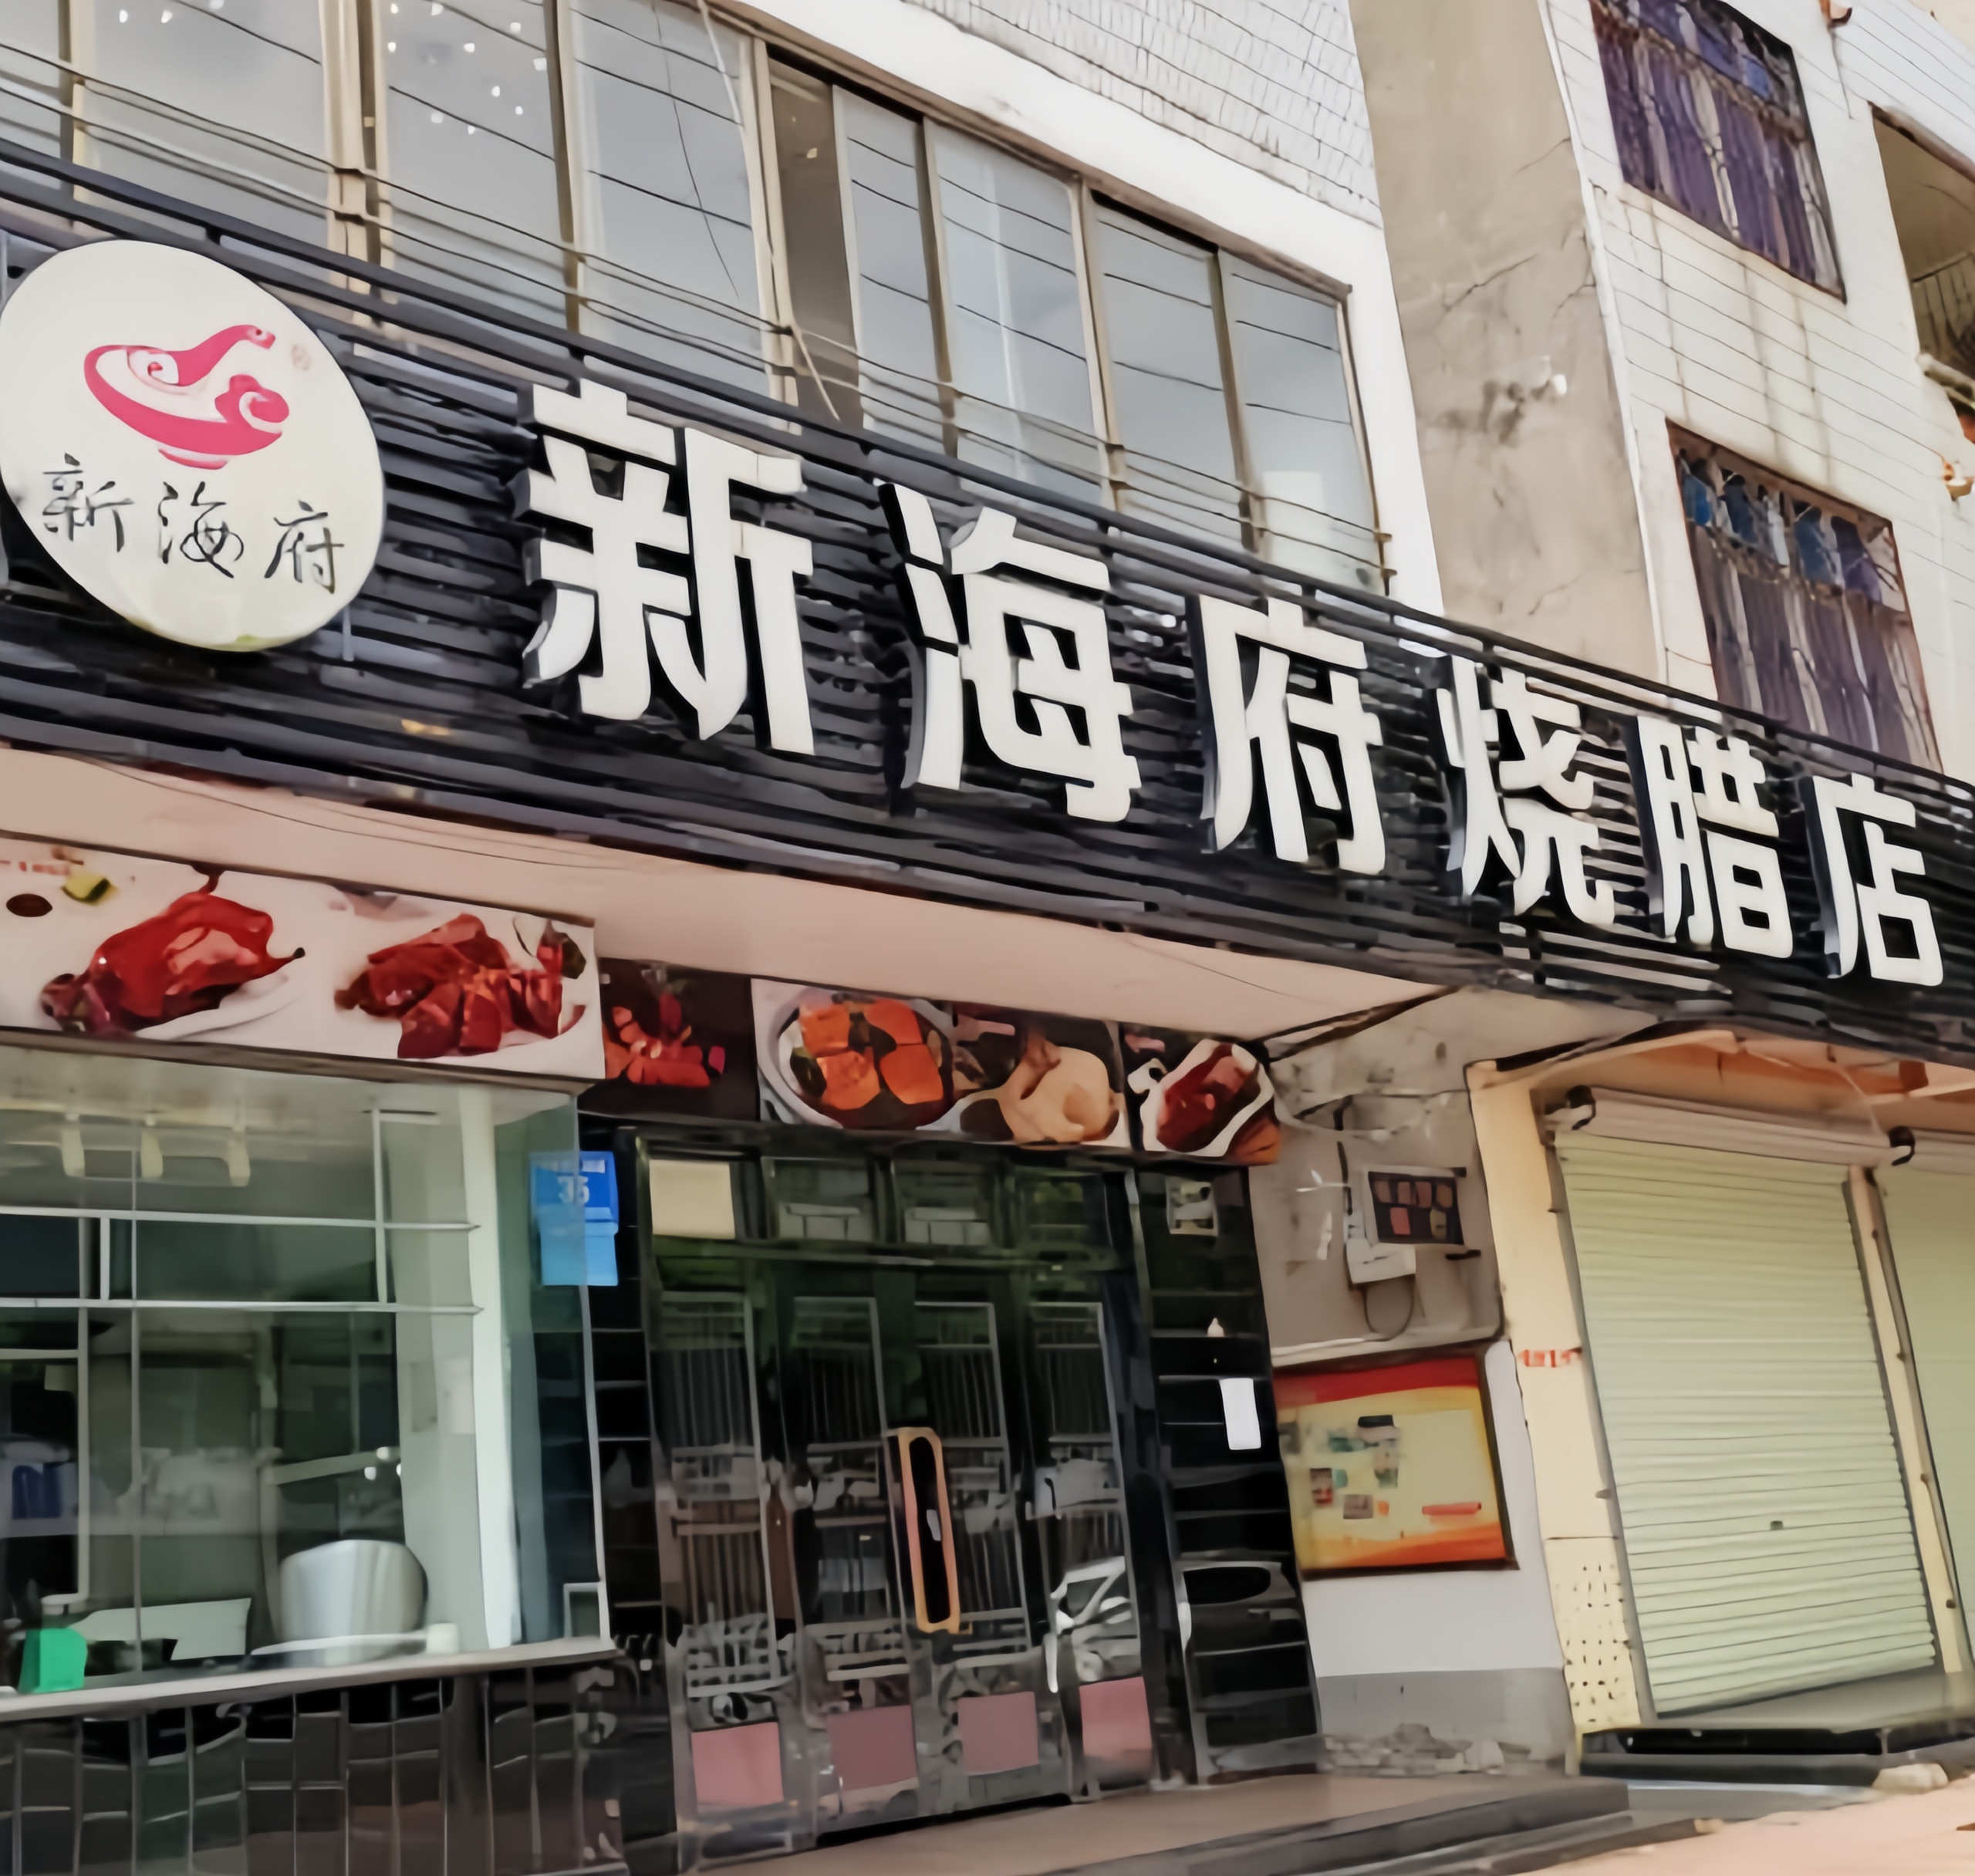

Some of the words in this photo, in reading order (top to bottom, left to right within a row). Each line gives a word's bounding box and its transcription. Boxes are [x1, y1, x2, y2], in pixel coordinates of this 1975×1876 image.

[42, 452, 346, 596] 新海府
[528, 378, 1944, 987] 新海府烧腊店
